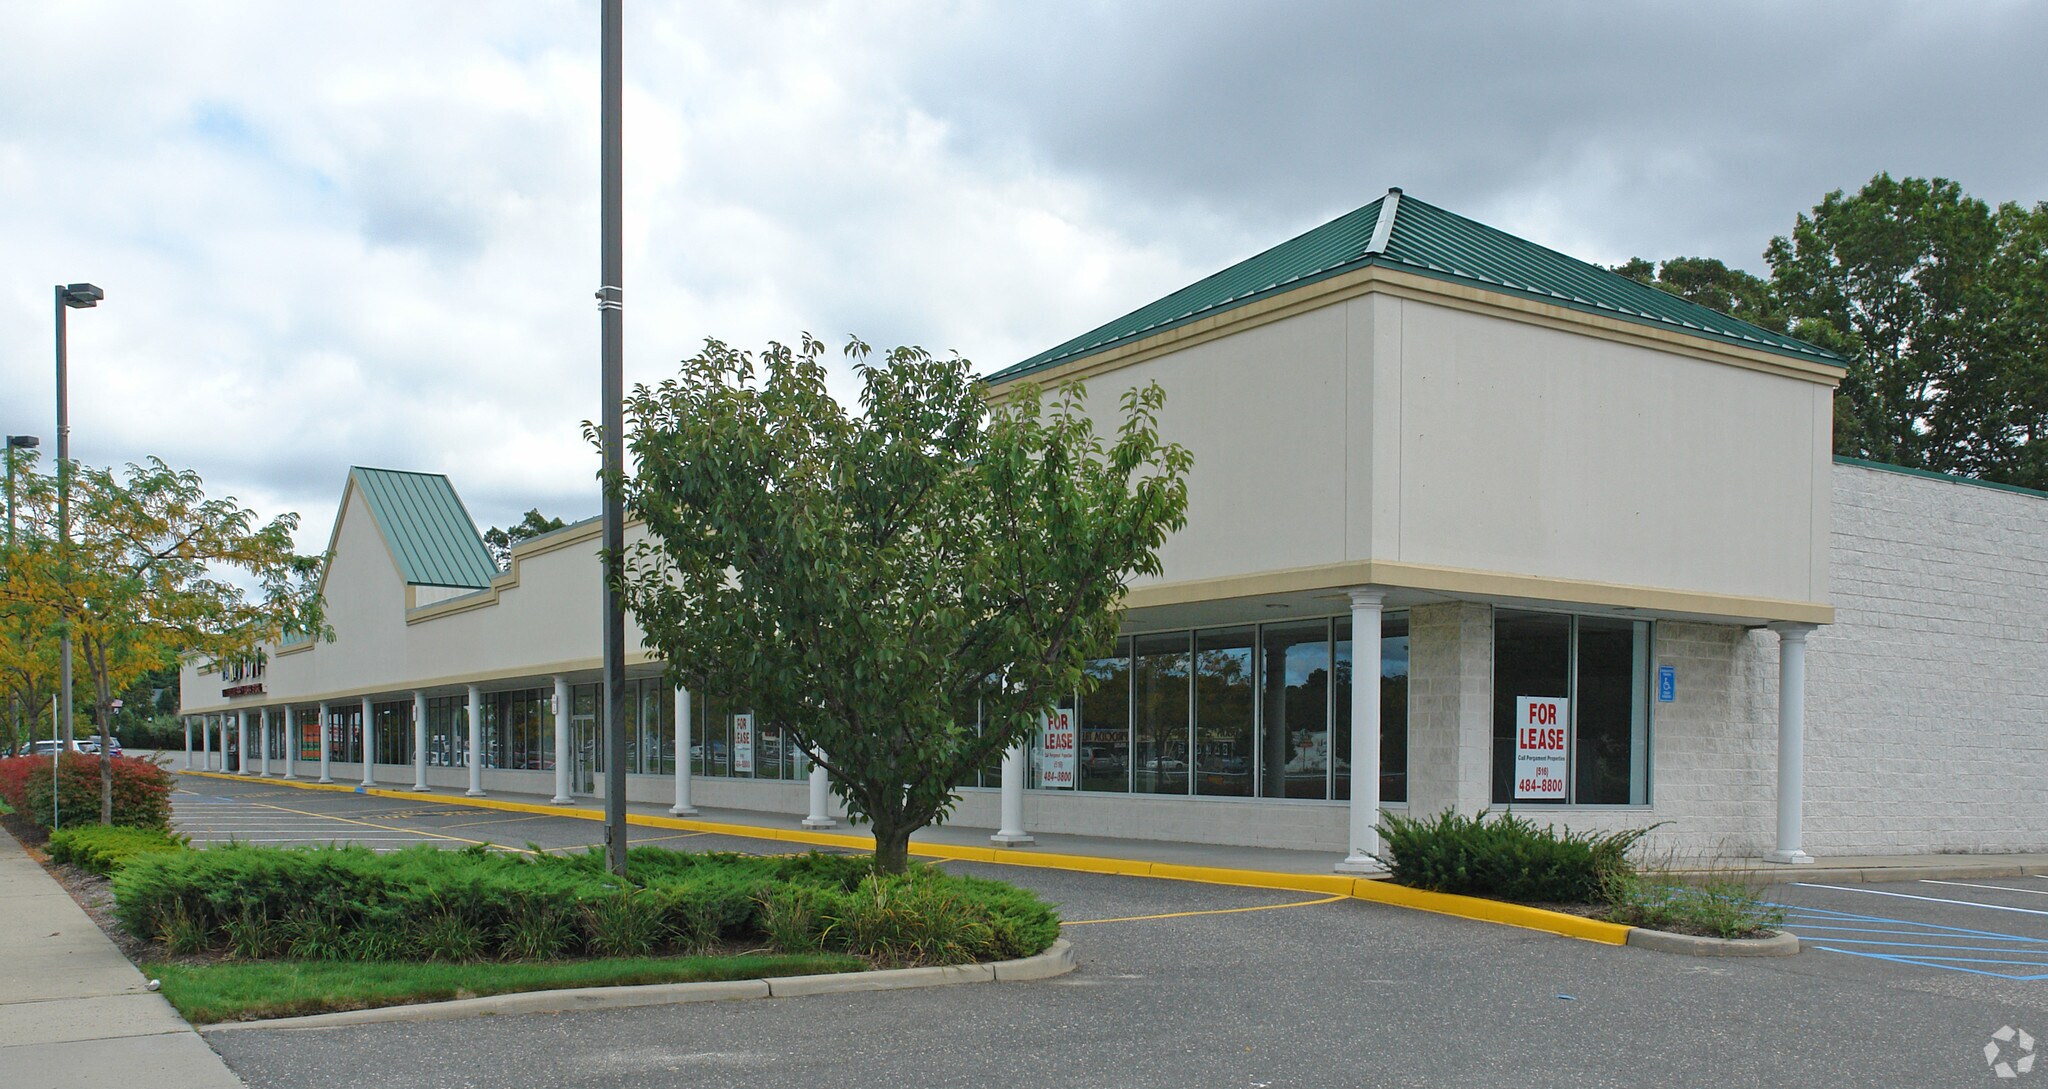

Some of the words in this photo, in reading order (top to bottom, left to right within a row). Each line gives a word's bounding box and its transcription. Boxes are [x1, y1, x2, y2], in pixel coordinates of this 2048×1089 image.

[1047, 714, 1068, 730] FOR
[1529, 703, 1557, 725] FOR
[737, 717, 747, 730] FOR
[1044, 733, 1073, 750] LEASE
[1520, 728, 1564, 750] LEASE
[1536, 766, 1549, 777] (516)
[1519, 778, 1563, 792] 484-8800
